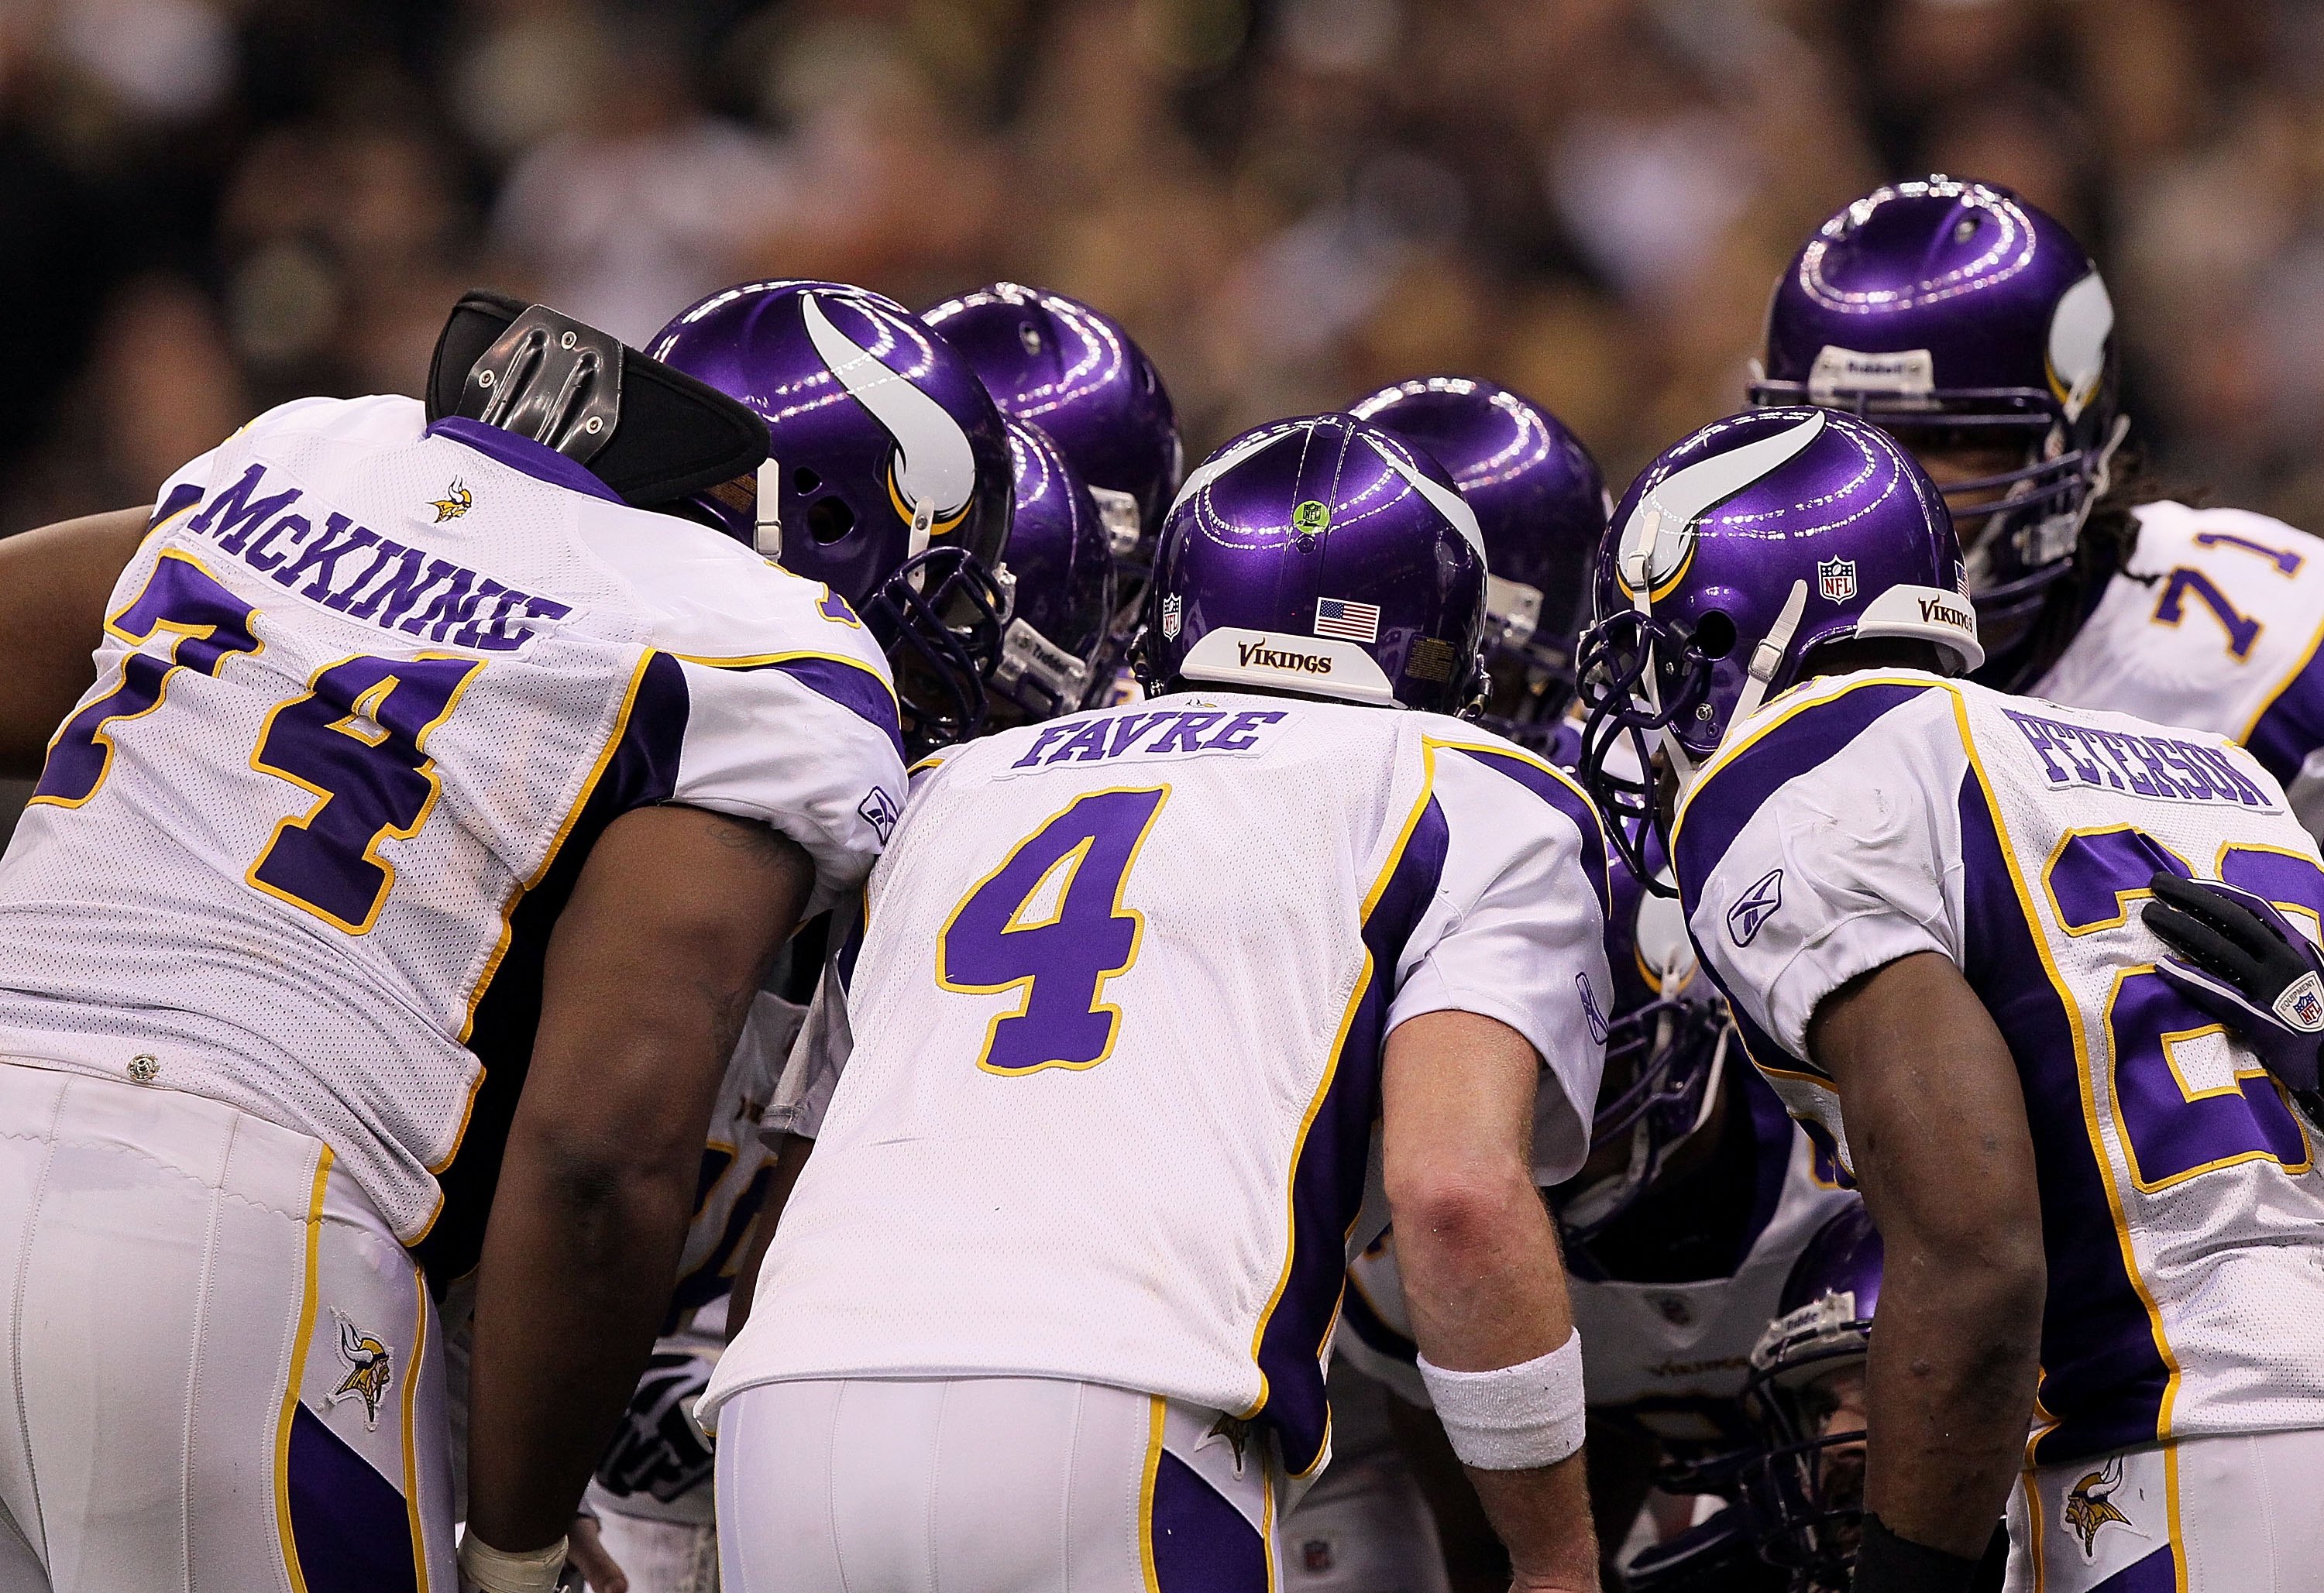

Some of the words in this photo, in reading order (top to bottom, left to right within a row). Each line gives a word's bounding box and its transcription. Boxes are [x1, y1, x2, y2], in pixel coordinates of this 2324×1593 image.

[1824, 577, 1852, 596] NFL
[2150, 532, 2307, 664] 71
[1164, 614, 1177, 633] NFL
[26, 548, 488, 936] 74
[1010, 711, 1288, 768] FAVRE
[2000, 708, 2273, 806] PETERSON
[935, 782, 1172, 1077] 4
[2280, 980, 2315, 1012] EQUIPMENT
[2300, 1002, 2322, 1023] NFL
